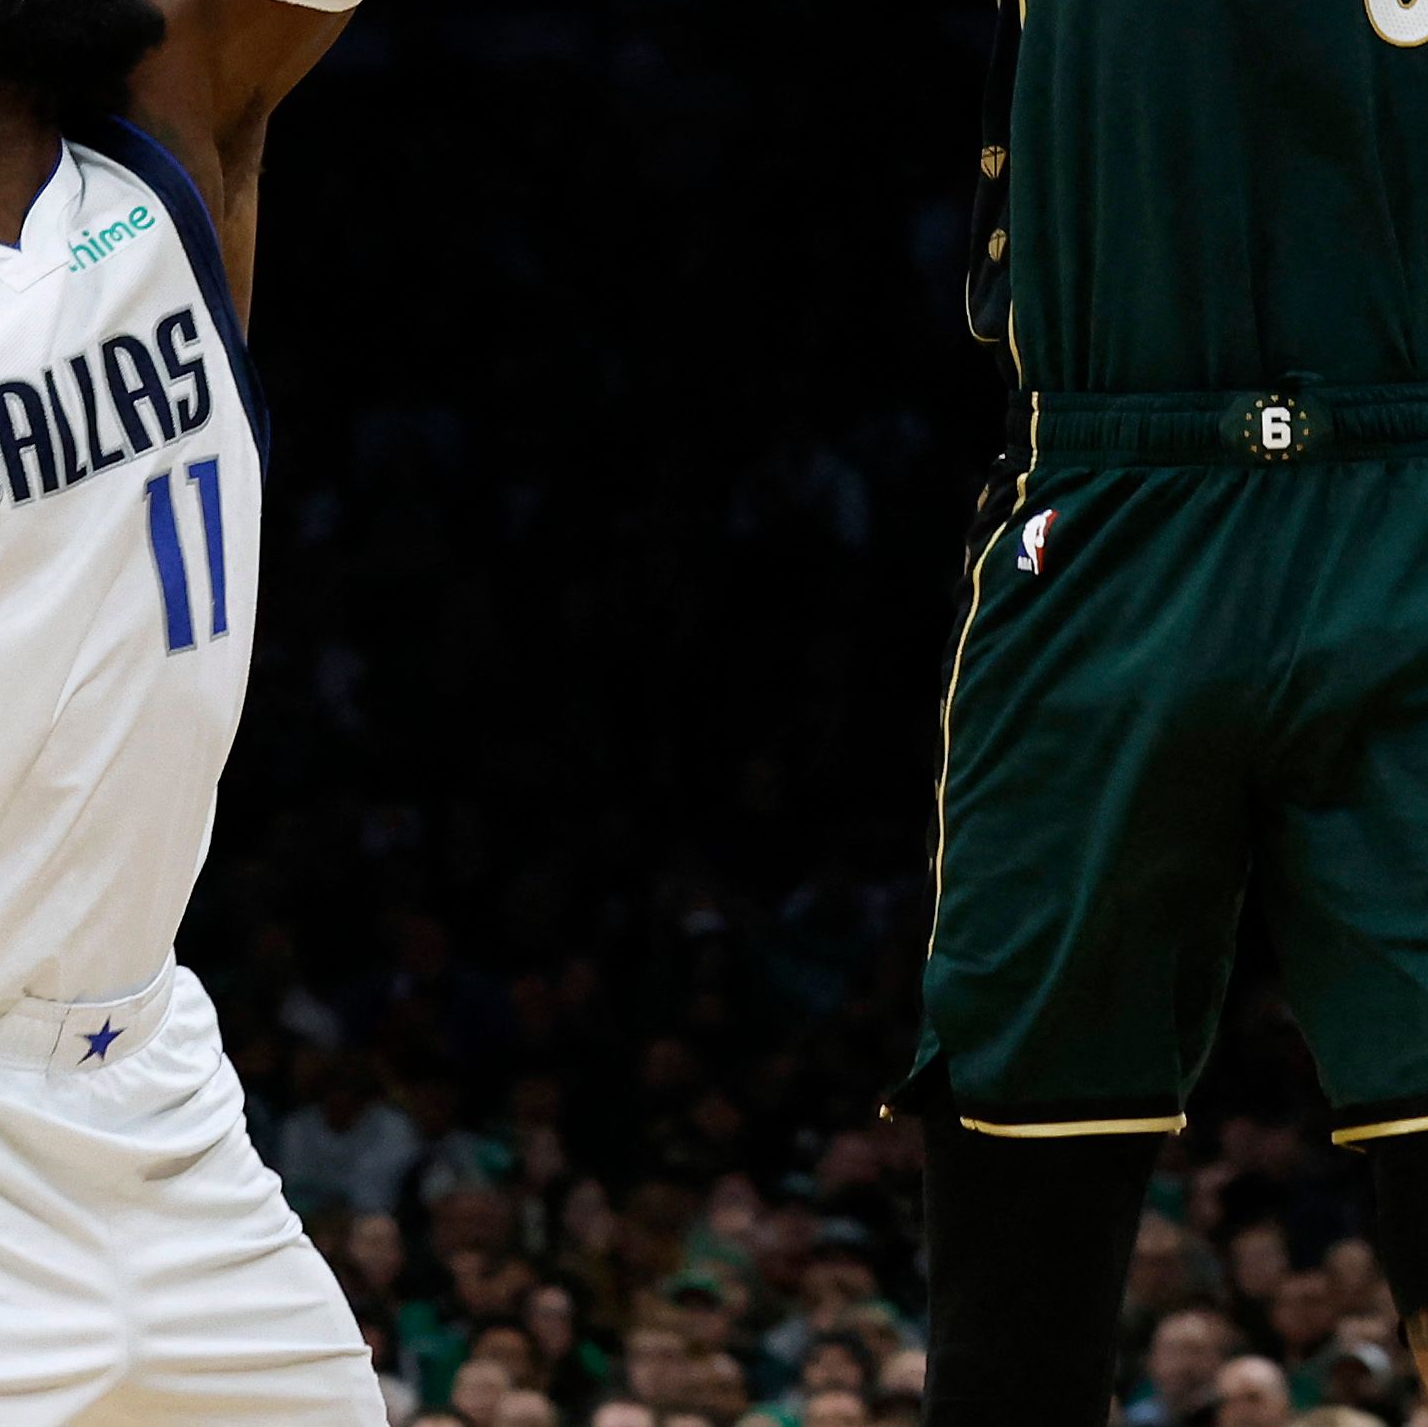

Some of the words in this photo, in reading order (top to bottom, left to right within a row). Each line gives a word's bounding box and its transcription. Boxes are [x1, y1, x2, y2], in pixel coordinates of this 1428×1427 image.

[68, 205, 156, 272] hime
[1261, 406, 1292, 450] 6
[143, 453, 230, 656] 11
